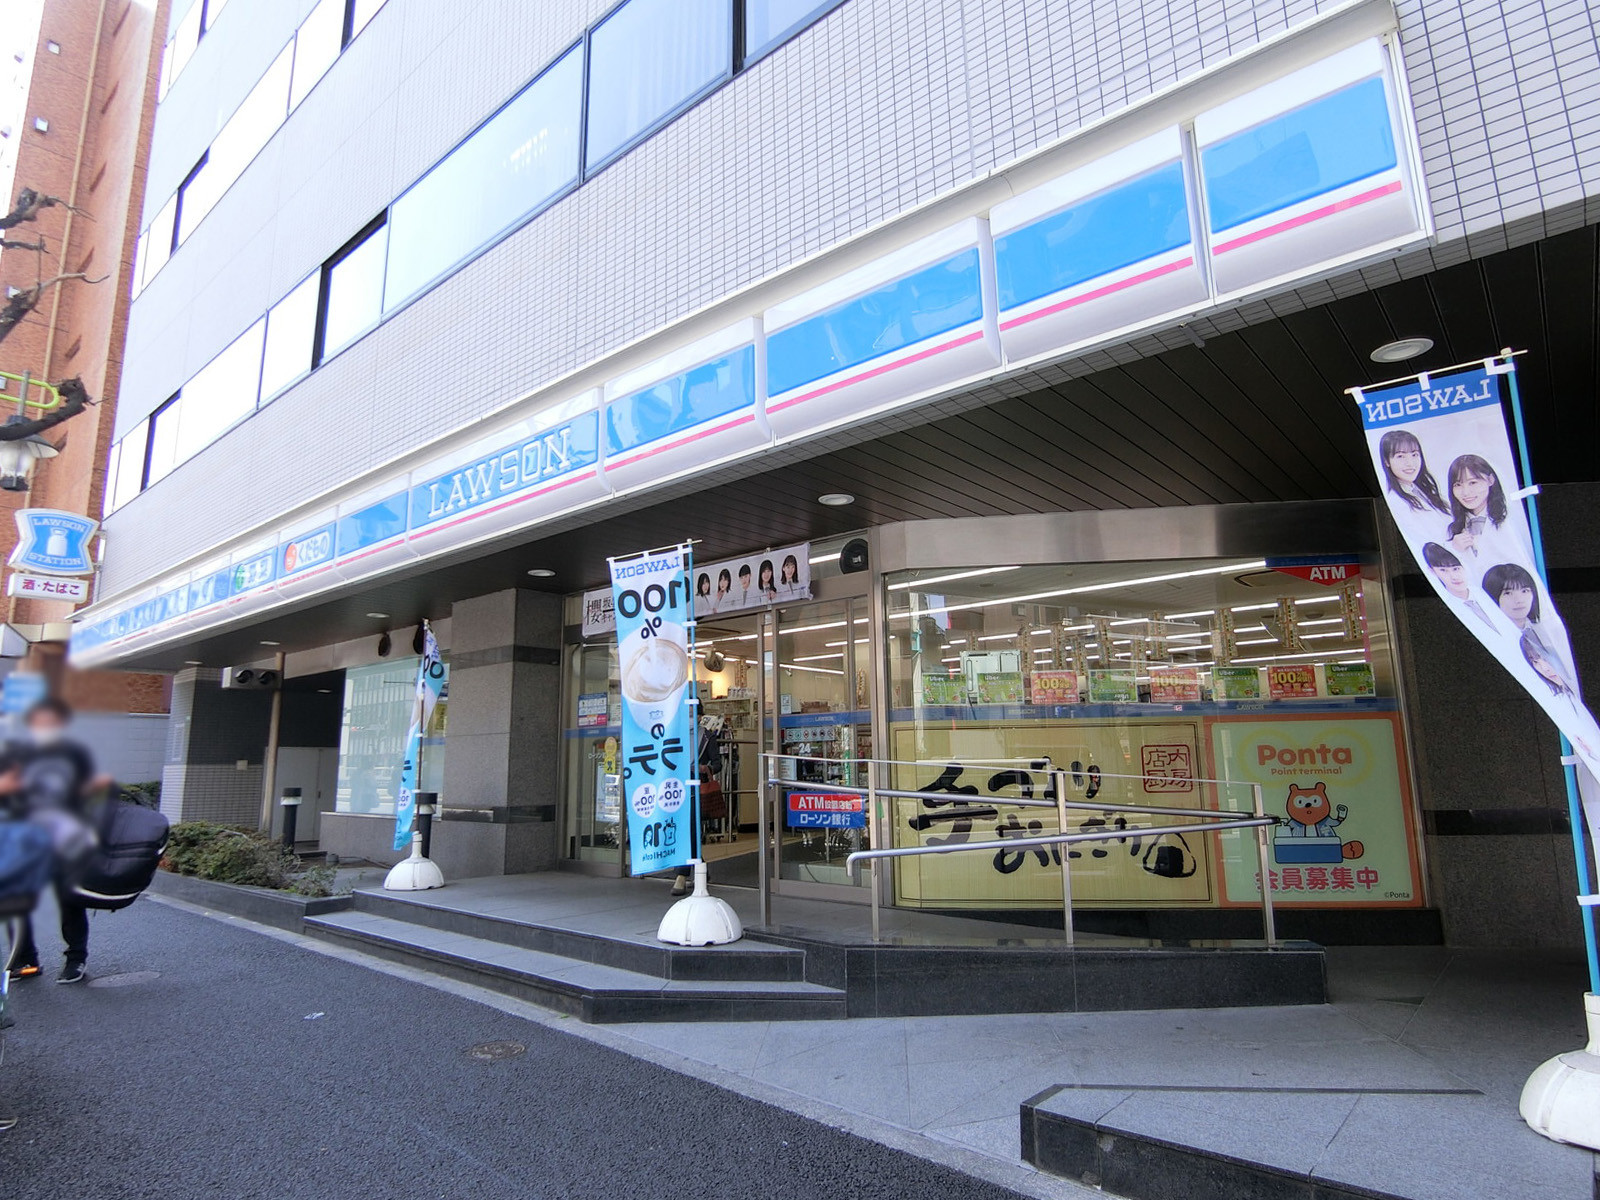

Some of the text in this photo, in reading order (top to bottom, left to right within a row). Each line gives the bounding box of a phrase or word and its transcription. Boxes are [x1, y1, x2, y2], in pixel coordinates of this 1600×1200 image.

[428, 427, 570, 518] LAWSON
[33, 518, 86, 532] LAWSON
[28, 553, 82, 565] STATION
[1310, 566, 1346, 580] ATM
[22, 579, 80, 595] 酒・たばこ
[798, 743, 811, 754] 24
[1257, 744, 1352, 766] Ponta
[1300, 766, 1342, 776] terminal
[800, 813, 851, 826] ローソン銀行
